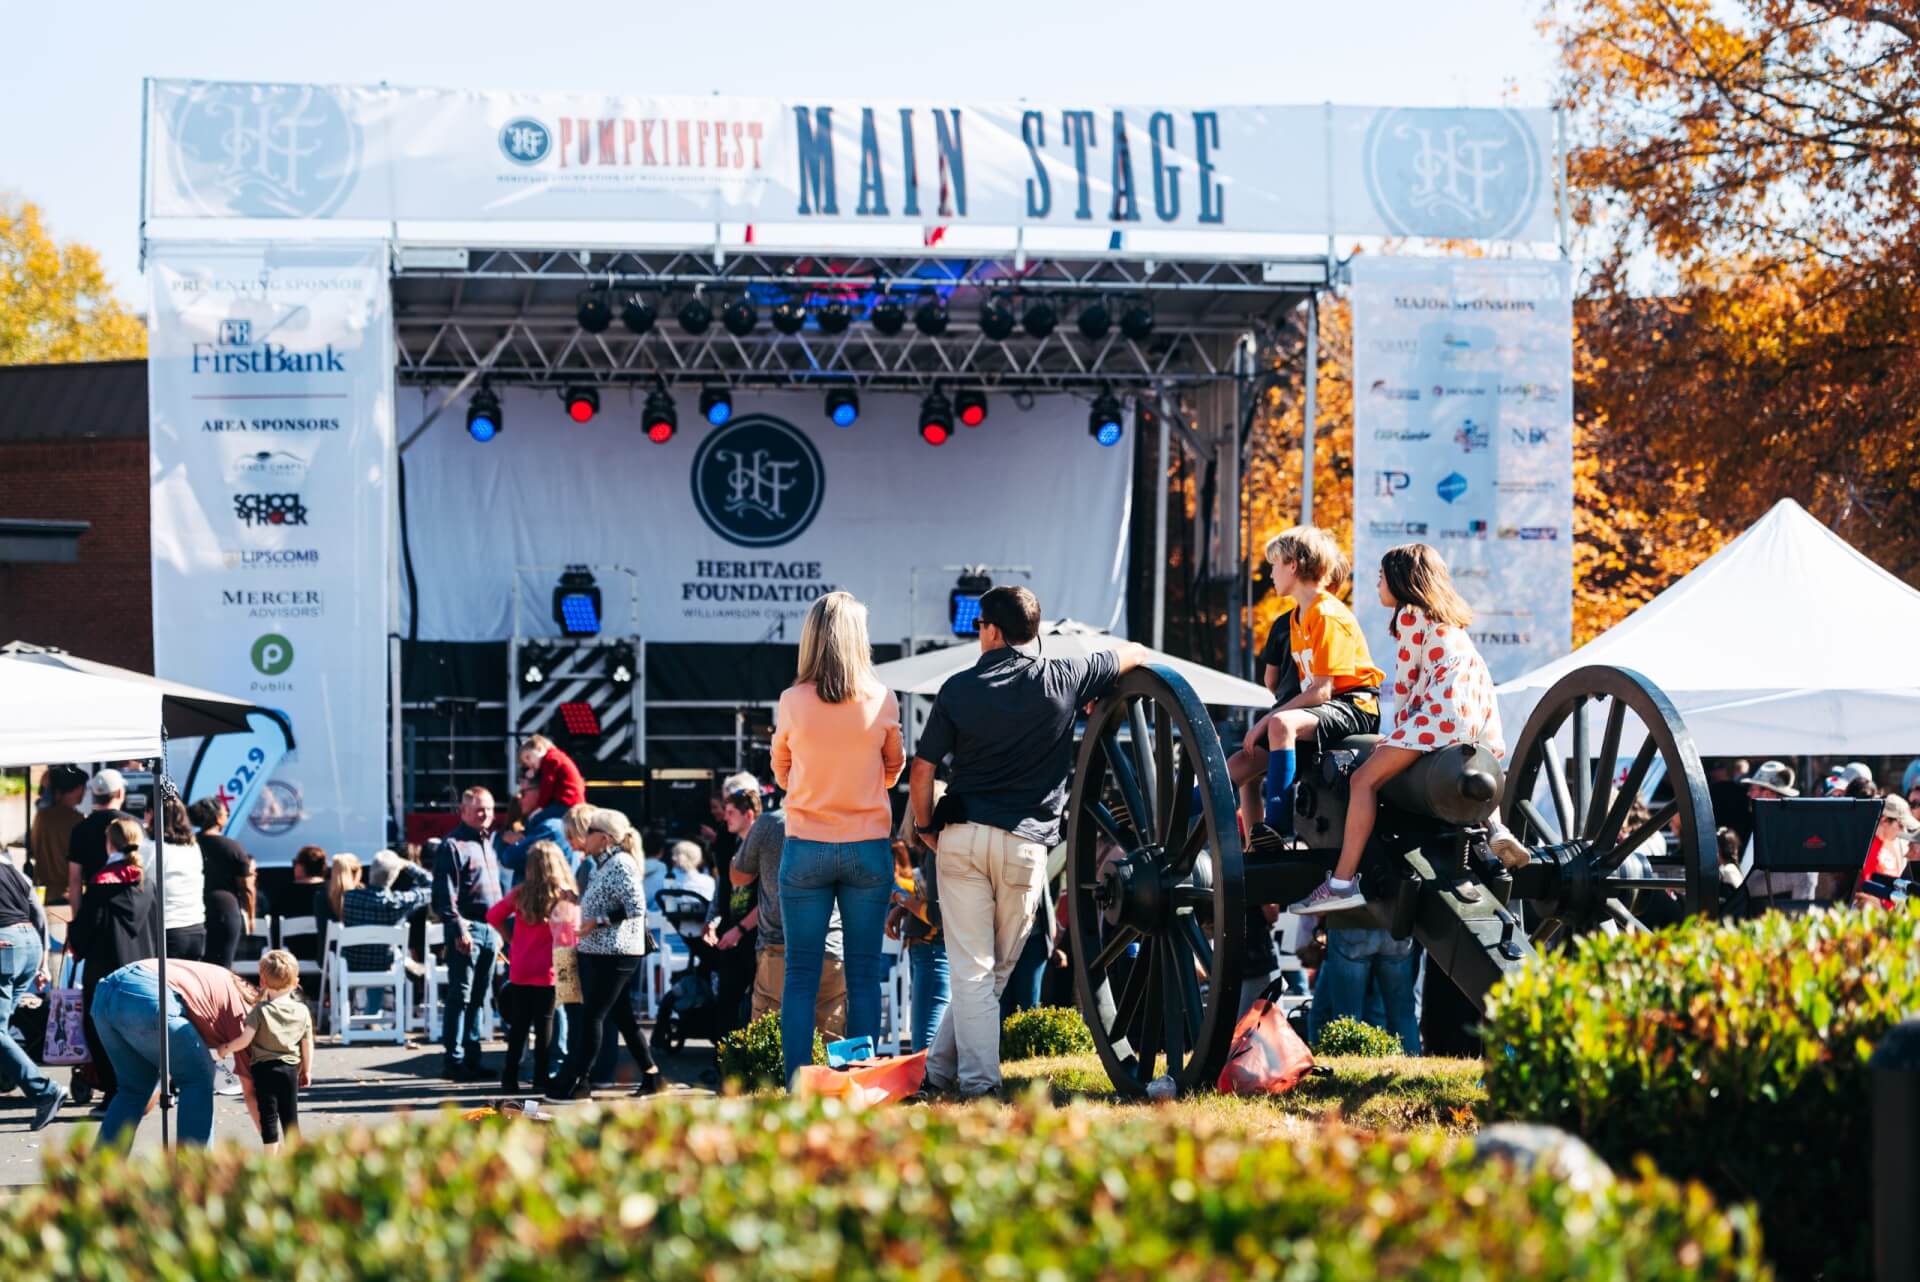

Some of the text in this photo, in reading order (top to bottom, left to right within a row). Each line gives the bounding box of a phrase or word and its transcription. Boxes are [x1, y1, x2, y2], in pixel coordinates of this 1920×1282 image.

[559, 117, 764, 169] PUMPKINFEST
[794, 106, 1225, 225] MAIN STAGE
[1394, 297, 1450, 311] MAJOR
[191, 343, 345, 374] FirstBank
[201, 418, 340, 432] AREA SPONSORS
[233, 493, 300, 511] SCHOOL
[241, 550, 319, 563] LIPSCOMB
[695, 559, 822, 579] HERITAGE
[222, 590, 321, 605] MERCER
[681, 582, 837, 601] FOUNDATION
[249, 607, 320, 618] ADVISORS
[682, 608, 808, 619] WILLIAMSON COUNT
[250, 681, 294, 692] Publix
[227, 747, 265, 796] 92.9
